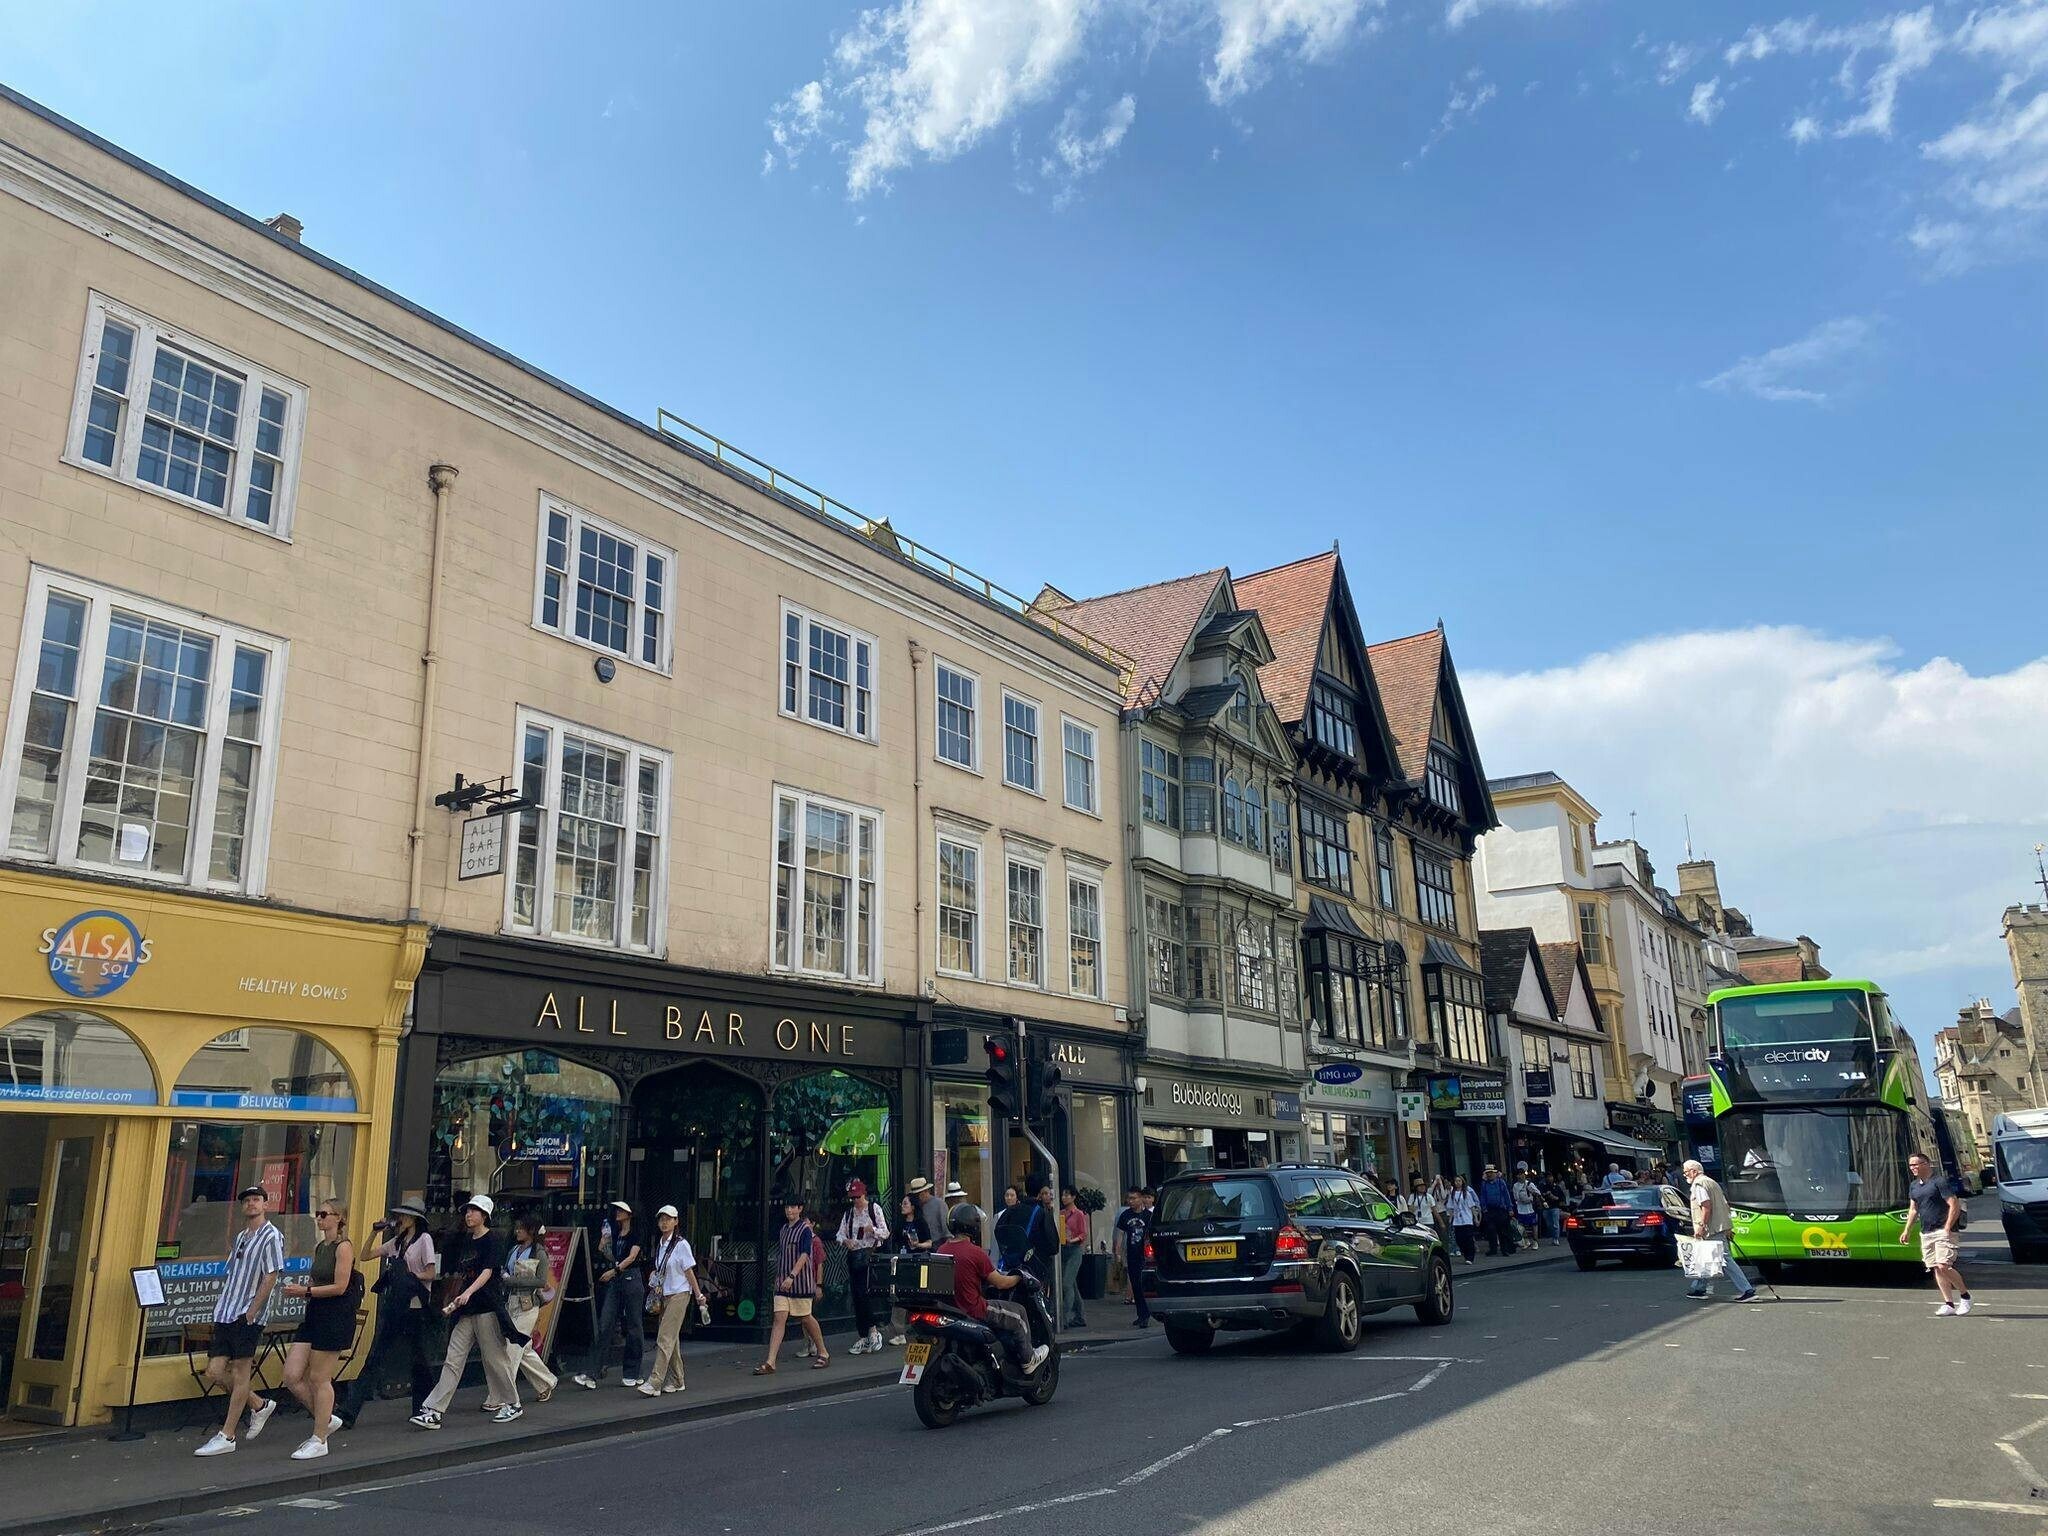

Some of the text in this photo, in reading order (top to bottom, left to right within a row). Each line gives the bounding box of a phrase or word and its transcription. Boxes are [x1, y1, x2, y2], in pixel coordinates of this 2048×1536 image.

[471, 822, 494, 837] ALL
[469, 838, 493, 854] BAR
[466, 854, 494, 870] ONE
[38, 927, 154, 965] SALSAS
[50, 957, 130, 979] DEL SOL
[238, 976, 349, 1001] HEALTHY BOWLS
[535, 991, 856, 1057] ALL BAR ONE
[1763, 1047, 1831, 1063] electricity
[1319, 1070, 1341, 1080] HMG
[239, 1095, 292, 1109] DELIVERY
[1172, 1082, 1242, 1116] Bubbleology
[1469, 1102, 1486, 1111] 7659
[1487, 1101, 1505, 1110] 4848
[1190, 1246, 1214, 1257] RX07
[175, 1312, 214, 1326] COFFEE
[905, 1364, 917, 1379] L
